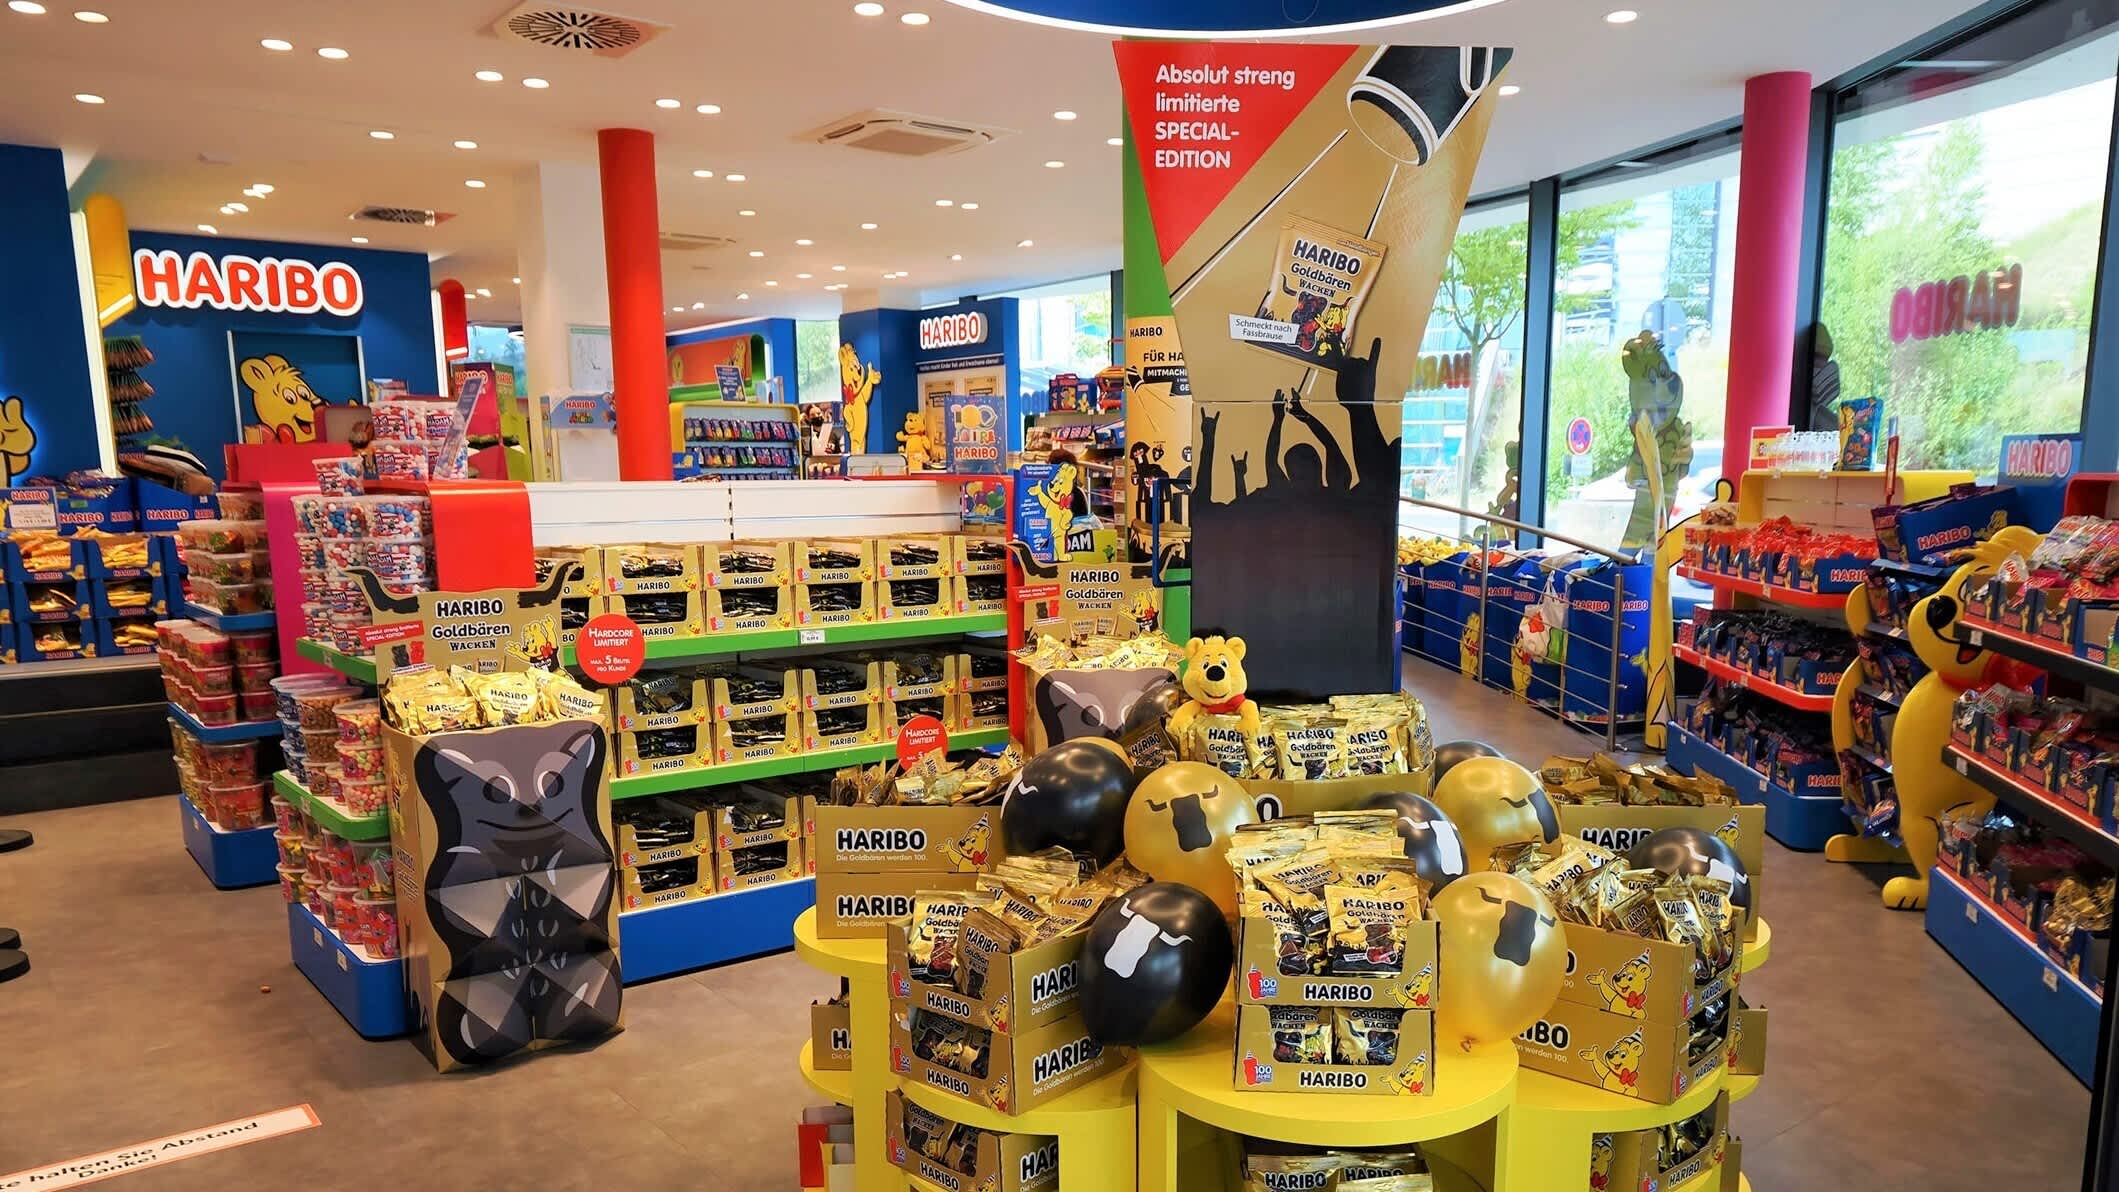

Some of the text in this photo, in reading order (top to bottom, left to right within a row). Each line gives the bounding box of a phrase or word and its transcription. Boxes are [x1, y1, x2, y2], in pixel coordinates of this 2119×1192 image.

[1155, 64, 1296, 90] Absolut streng
[1155, 92, 1240, 113] limitierte
[1155, 121, 1240, 141] SPECIAL-
[1155, 149, 1230, 169] EDITION
[1292, 239, 1361, 275] HARIBO
[136, 250, 362, 314] HARIBO
[1291, 262, 1351, 291] Goldbären
[1298, 278, 1336, 298] WACKEN
[921, 314, 980, 348] HARIBO
[1129, 326, 1163, 338] HARIBO
[1235, 318, 1292, 333] Schmeckt nach
[1242, 329, 1284, 341] Fassbrause
[1143, 349, 1185, 362] FÜR HA
[1179, 384, 1190, 392] GE
[954, 446, 998, 459] HARIBO
[2007, 439, 2072, 477] HARIBO
[60, 511, 104, 524] HARIBO
[147, 509, 189, 520] HARIBO
[1917, 525, 1972, 551] HARIBO
[902, 568, 929, 577] HARIBO
[977, 563, 1001, 572] HARIBO
[733, 576, 764, 585] HARIBO
[821, 572, 849, 580] HARIBO
[1070, 570, 1120, 583] HARIBO
[1830, 568, 1869, 583] HARIB
[637, 581, 670, 591] HARIBO
[1066, 588, 1123, 599] Goldbären
[437, 599, 504, 617] HARIBO
[978, 603, 1003, 611] HARIBO
[1573, 599, 1610, 612] HARIBO
[822, 614, 850, 622] HARIBO
[903, 608, 929, 617] HARIBO
[432, 622, 511, 639] Goldbären
[736, 620, 766, 629] HARIBO
[588, 627, 634, 638] HARDCORE
[641, 627, 674, 636] HARIBO
[450, 639, 497, 651] WACKEN
[593, 638, 629, 647] LIMITIERT
[604, 654, 612, 665] 5
[982, 679, 1006, 688] HARIBO
[1816, 672, 1841, 685] HAR
[908, 687, 934, 697] HARIBO
[559, 691, 595, 709] HARIBO
[829, 695, 857, 705] HARIBO
[743, 705, 773, 715] HARIBO
[647, 716, 679, 726] HARIBO
[983, 717, 1008, 727] HARIBO
[830, 736, 857, 746] HARIBO
[1286, 728, 1335, 741] HARIBO
[1347, 729, 1388, 745] ARIBO
[745, 748, 774, 758] HARIBO
[1290, 742, 1336, 752] Goldbären
[652, 759, 684, 770] HARIBO
[744, 833, 774, 845] HARIBO
[836, 829, 926, 852] HARIBO
[650, 848, 681, 862] HARIBO
[836, 853, 928, 862] Die Goldbären werden 100.
[747, 873, 776, 886] HARIBO
[654, 890, 686, 904] HARIBO
[926, 903, 980, 919] HARIB
[1006, 899, 1040, 923] HARIBO
[1343, 898, 1405, 911] HARIBO
[836, 920, 848, 928] Die
[925, 917, 961, 929] Goldbä
[1032, 961, 1079, 1004] HARI
[1259, 979, 1277, 988] 100
[1304, 985, 1373, 1001] HARIBO
[1701, 980, 1723, 1003] HARIBO
[927, 991, 970, 1018] HARIBO
[1523, 1045, 1569, 1064] werden 100.
[1254, 1066, 1272, 1075] 100
[1695, 1055, 1717, 1081] HARIBO
[927, 1069, 970, 1096] HARIBO
[1299, 1071, 1368, 1088] HARIBO
[30, 1121, 258, 1182] halten Sie Abstand
[79, 1154, 158, 1179] Danke!
[1022, 1140, 1058, 1180] HAR
[920, 1162, 960, 1192] HARIBO
[1265, 1172, 1327, 1189] HARIBO
[1669, 1160, 1700, 1188] HARIBO
